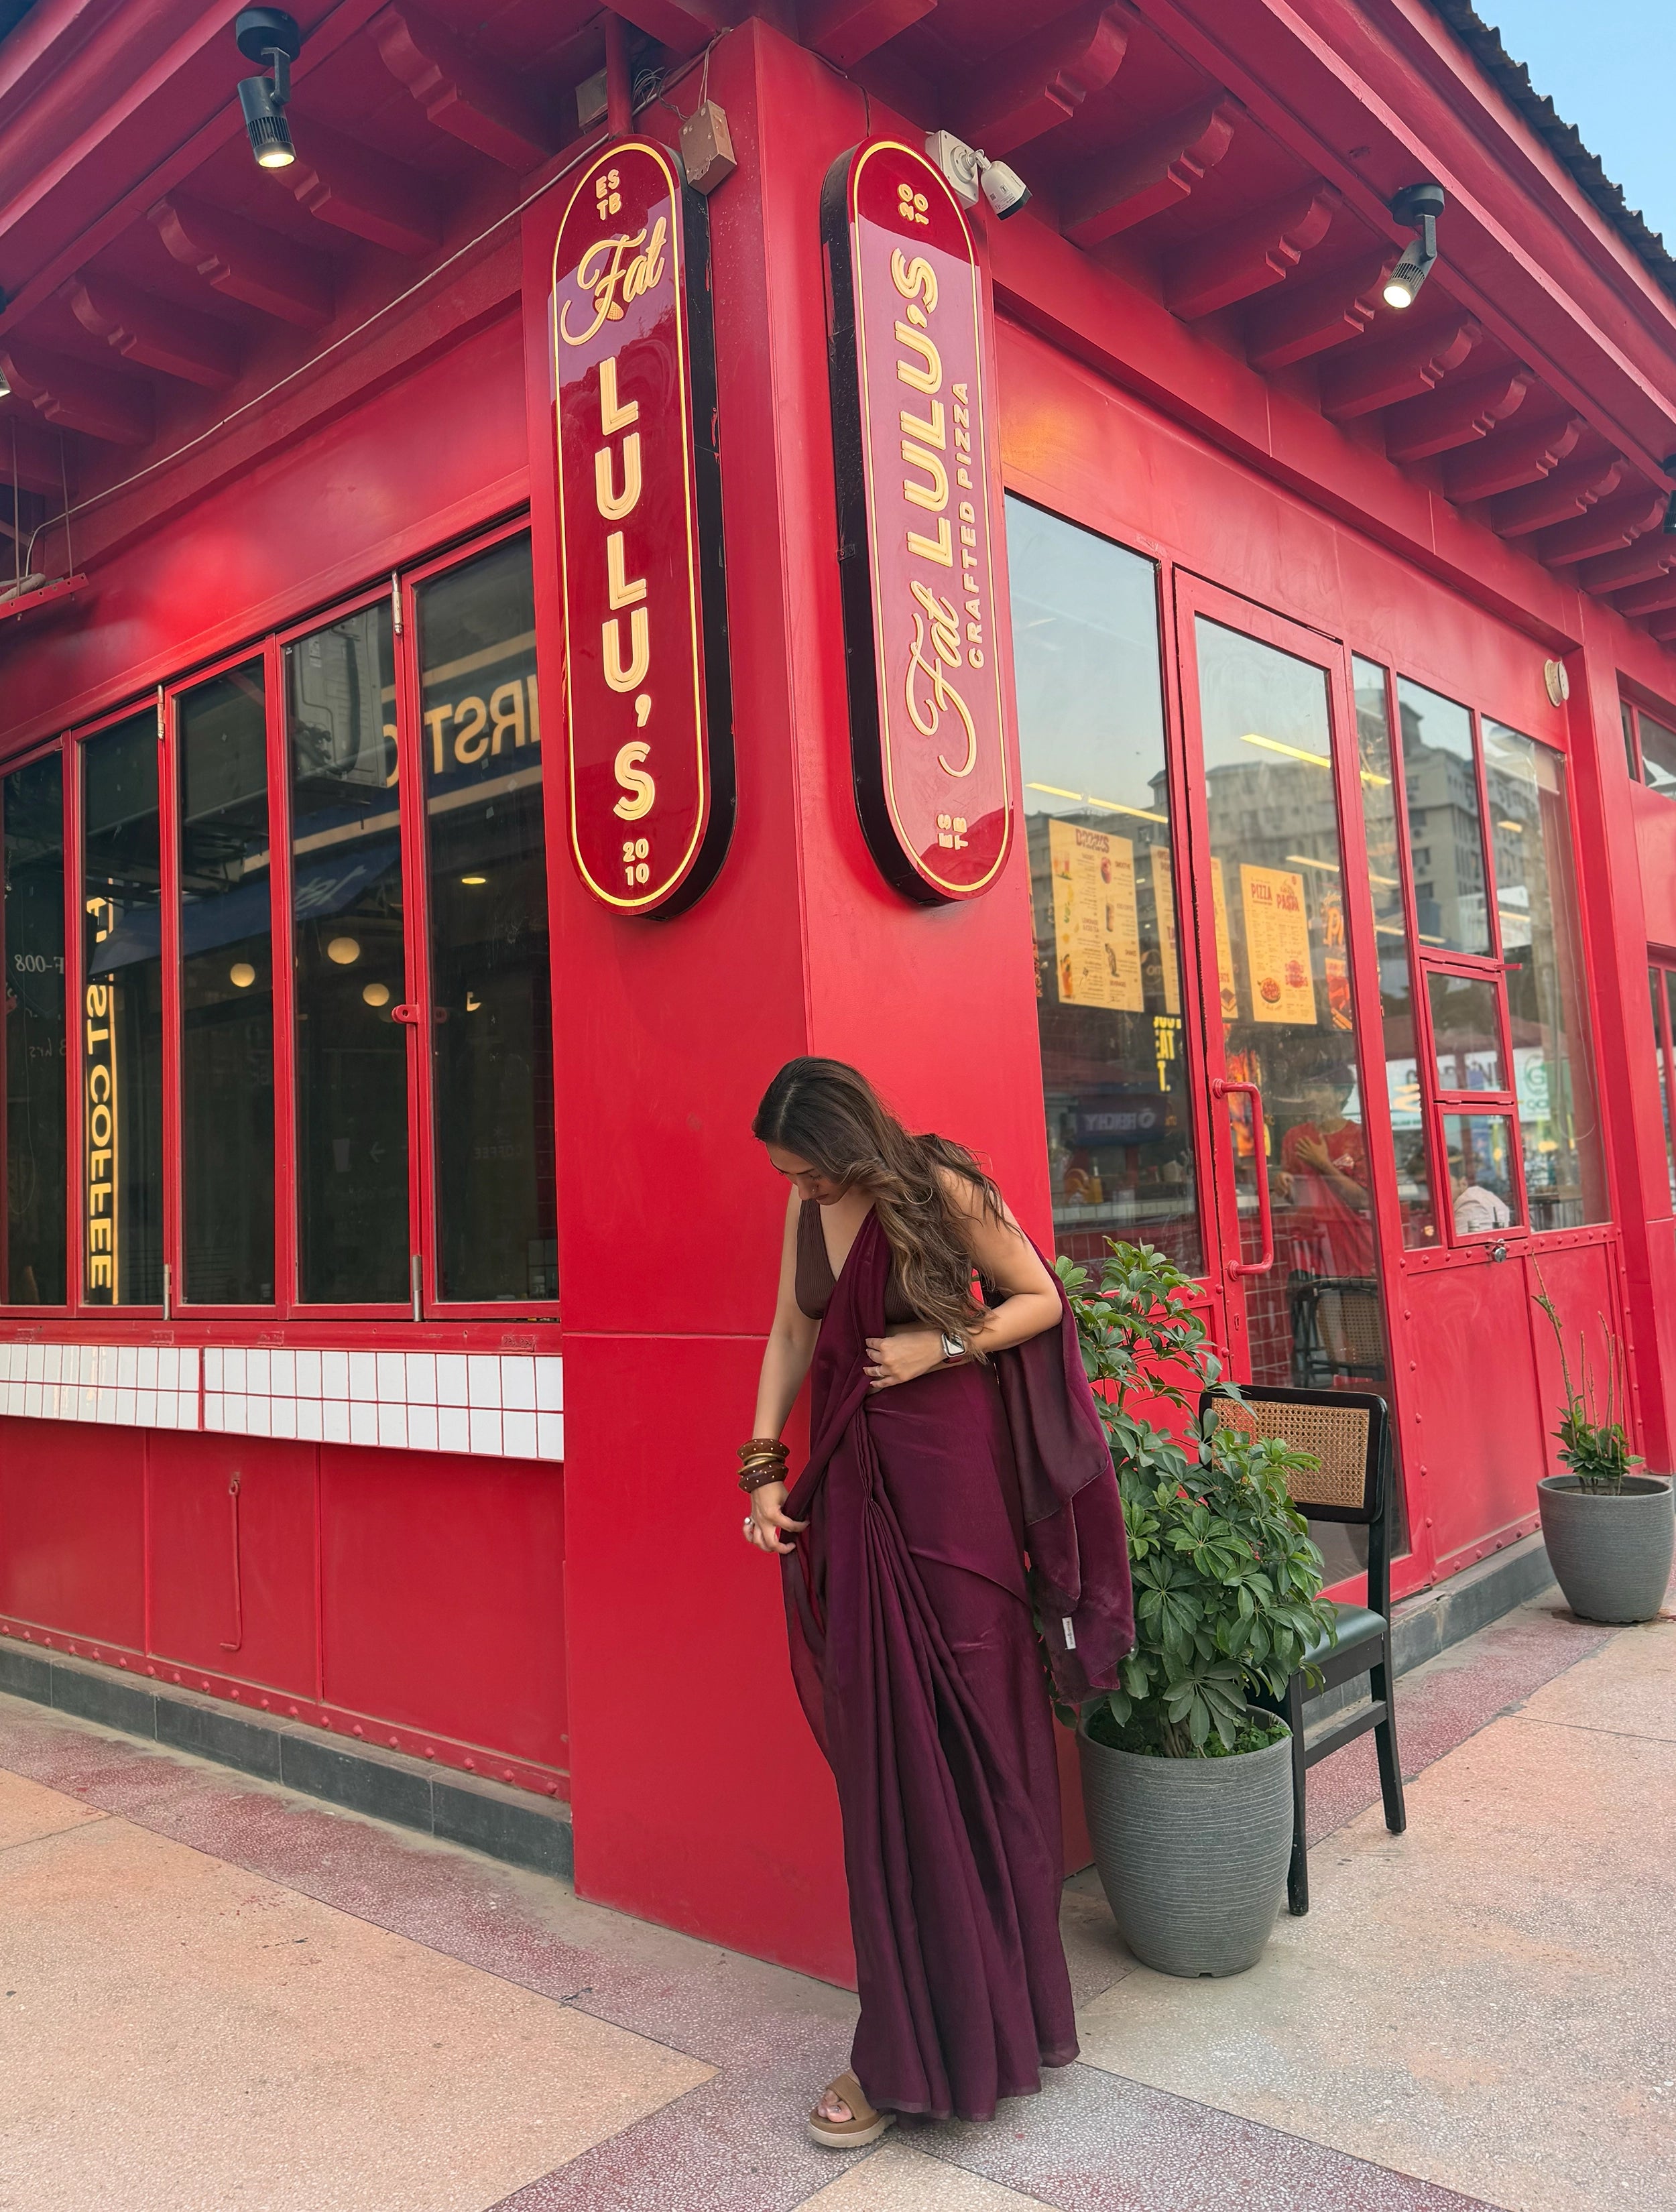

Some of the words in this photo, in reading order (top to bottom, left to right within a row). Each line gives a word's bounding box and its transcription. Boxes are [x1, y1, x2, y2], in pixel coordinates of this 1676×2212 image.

[595, 169, 619, 200] ES
[898, 183, 916, 221] 20
[596, 192, 622, 221] TB
[913, 192, 929, 225] 10
[560, 216, 668, 347] Fat
[890, 247, 953, 568] LULU'S
[952, 383, 973, 489] PIZZA
[594, 355, 656, 820] LULU'S
[959, 501, 985, 669] CRAFTED
[905, 580, 978, 778] Fat
[938, 812, 952, 849] ES
[953, 816, 969, 851] TB
[622, 837, 649, 863] 20
[624, 861, 650, 886] 10
[1250, 882, 1273, 902] PIZZA
